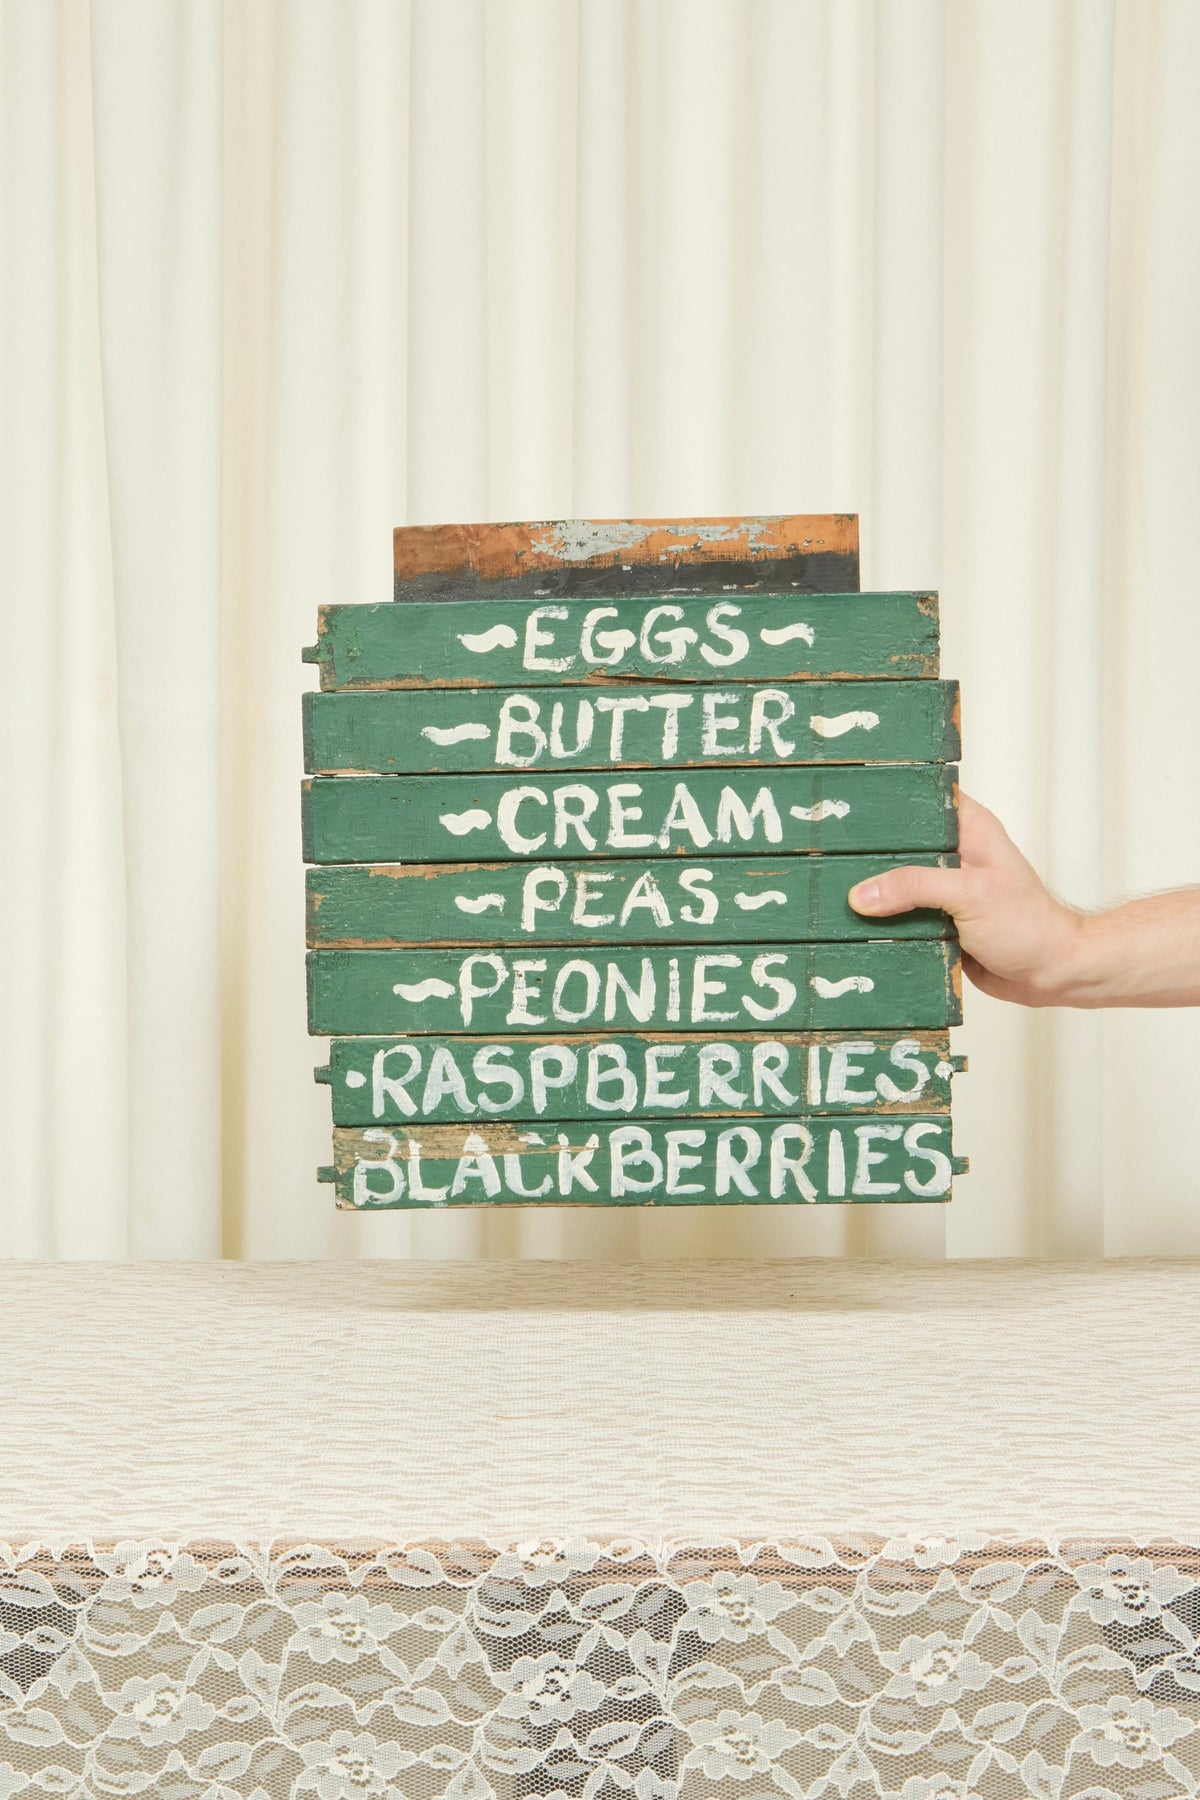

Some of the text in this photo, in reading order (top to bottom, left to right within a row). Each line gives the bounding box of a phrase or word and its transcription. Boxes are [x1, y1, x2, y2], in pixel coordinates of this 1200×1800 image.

[523, 602, 750, 672] EGGS
[495, 688, 796, 767] BUTTER
[496, 783, 784, 854] CREAM
[520, 866, 719, 932] PEAS
[458, 953, 796, 1027] PEONIES
[352, 1122, 953, 1208] BLACKBERRIES
